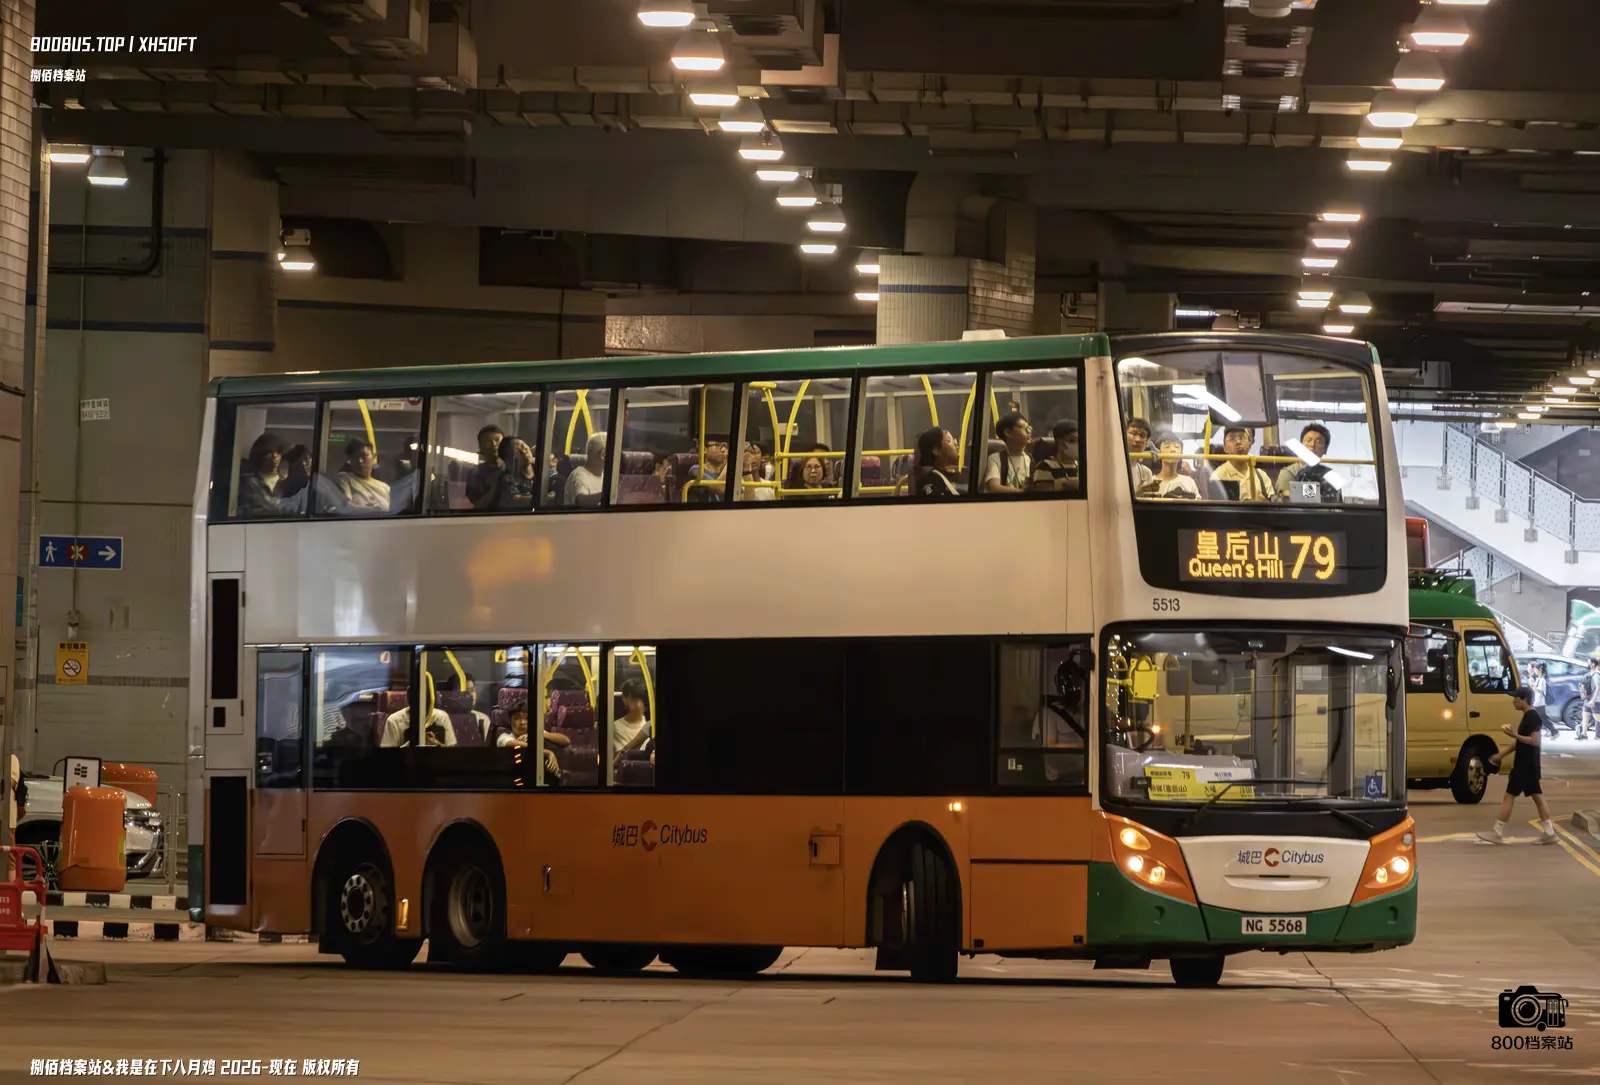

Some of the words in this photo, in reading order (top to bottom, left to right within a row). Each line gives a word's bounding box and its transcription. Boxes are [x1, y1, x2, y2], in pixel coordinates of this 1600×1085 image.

[1196, 530, 1279, 561] 皇后山
[1289, 535, 1336, 580] 79
[1188, 557, 1255, 578] Queen's
[1257, 559, 1284, 579] Hill
[1152, 598, 1180, 612] 5513
[1181, 770, 1191, 780] 79
[612, 824, 639, 847] 城巴
[660, 824, 708, 847] Citybus
[1237, 850, 1262, 865] 城巴
[1281, 850, 1325, 865] Citybus
[1245, 919, 1263, 933] NG
[1268, 919, 1303, 933] 5568
